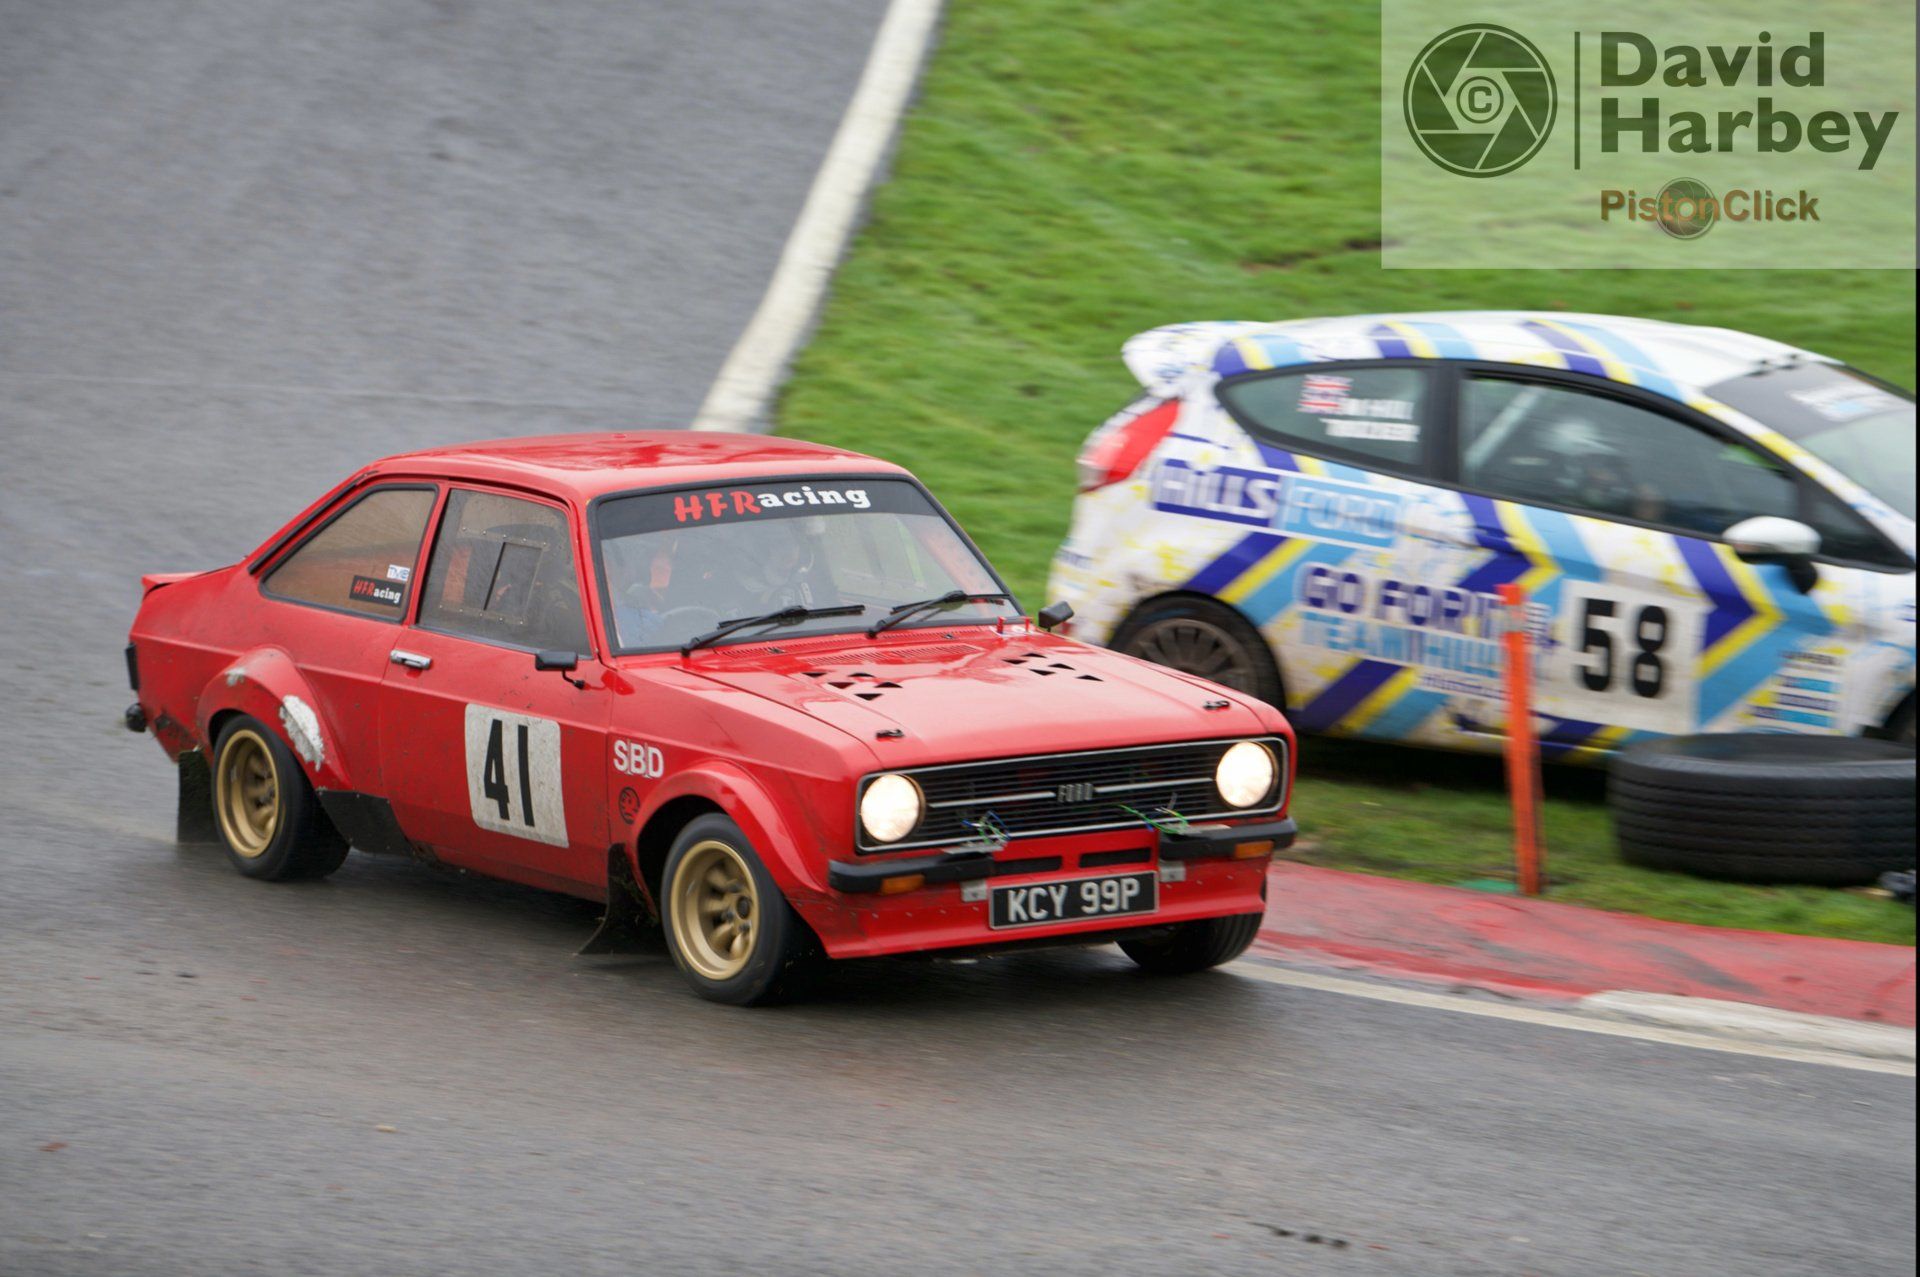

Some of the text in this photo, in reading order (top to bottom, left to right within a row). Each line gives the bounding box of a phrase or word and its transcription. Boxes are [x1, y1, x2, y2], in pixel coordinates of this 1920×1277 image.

[674, 486, 871, 523] HFRacing
[1304, 566, 1365, 614] GO
[1377, 579, 1467, 635] FOR
[1576, 596, 1670, 699] 58
[484, 718, 535, 828] 41
[613, 739, 664, 778] SBD
[1007, 877, 1141, 923] KCY 99P
